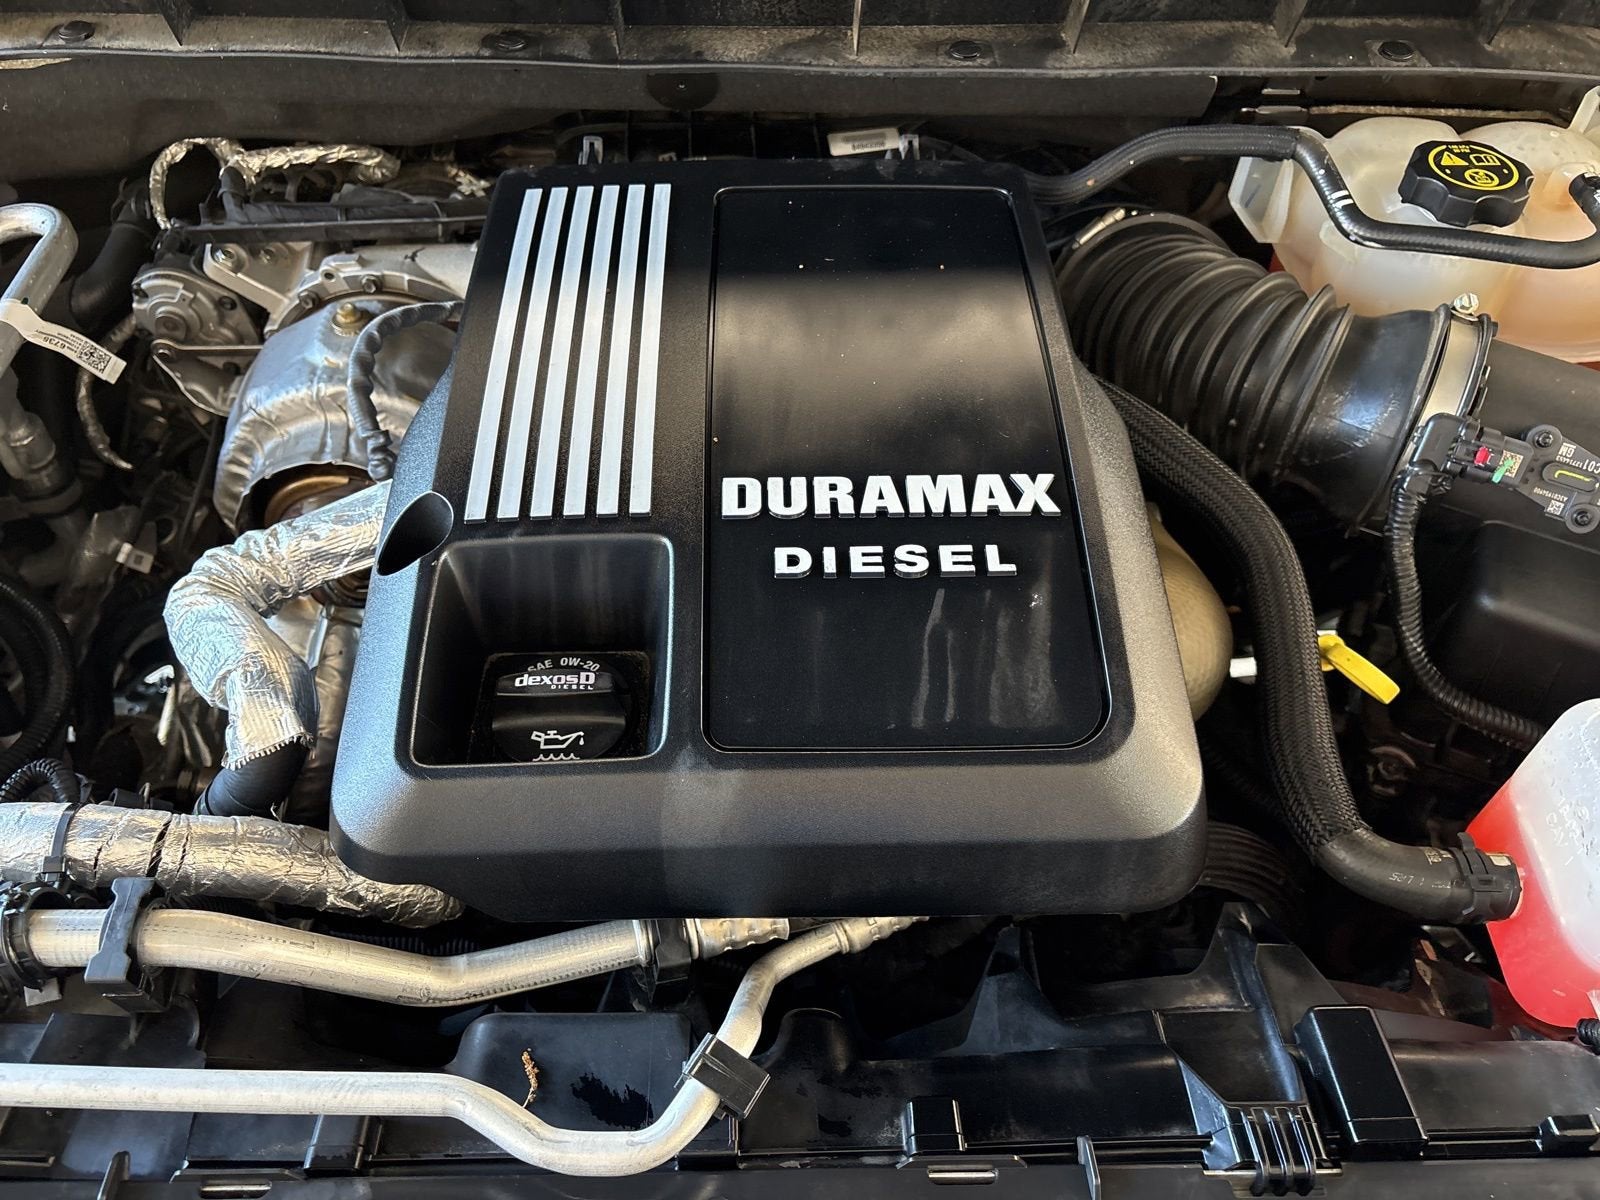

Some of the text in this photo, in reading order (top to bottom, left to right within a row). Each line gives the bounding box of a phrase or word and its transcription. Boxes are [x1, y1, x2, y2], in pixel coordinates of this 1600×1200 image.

[1559, 444, 1575, 457] GM
[721, 473, 1062, 519] DURAMAX
[774, 544, 1018, 579] DIESEL
[560, 657, 601, 672] 0W-20
[514, 672, 596, 687] dexosD
